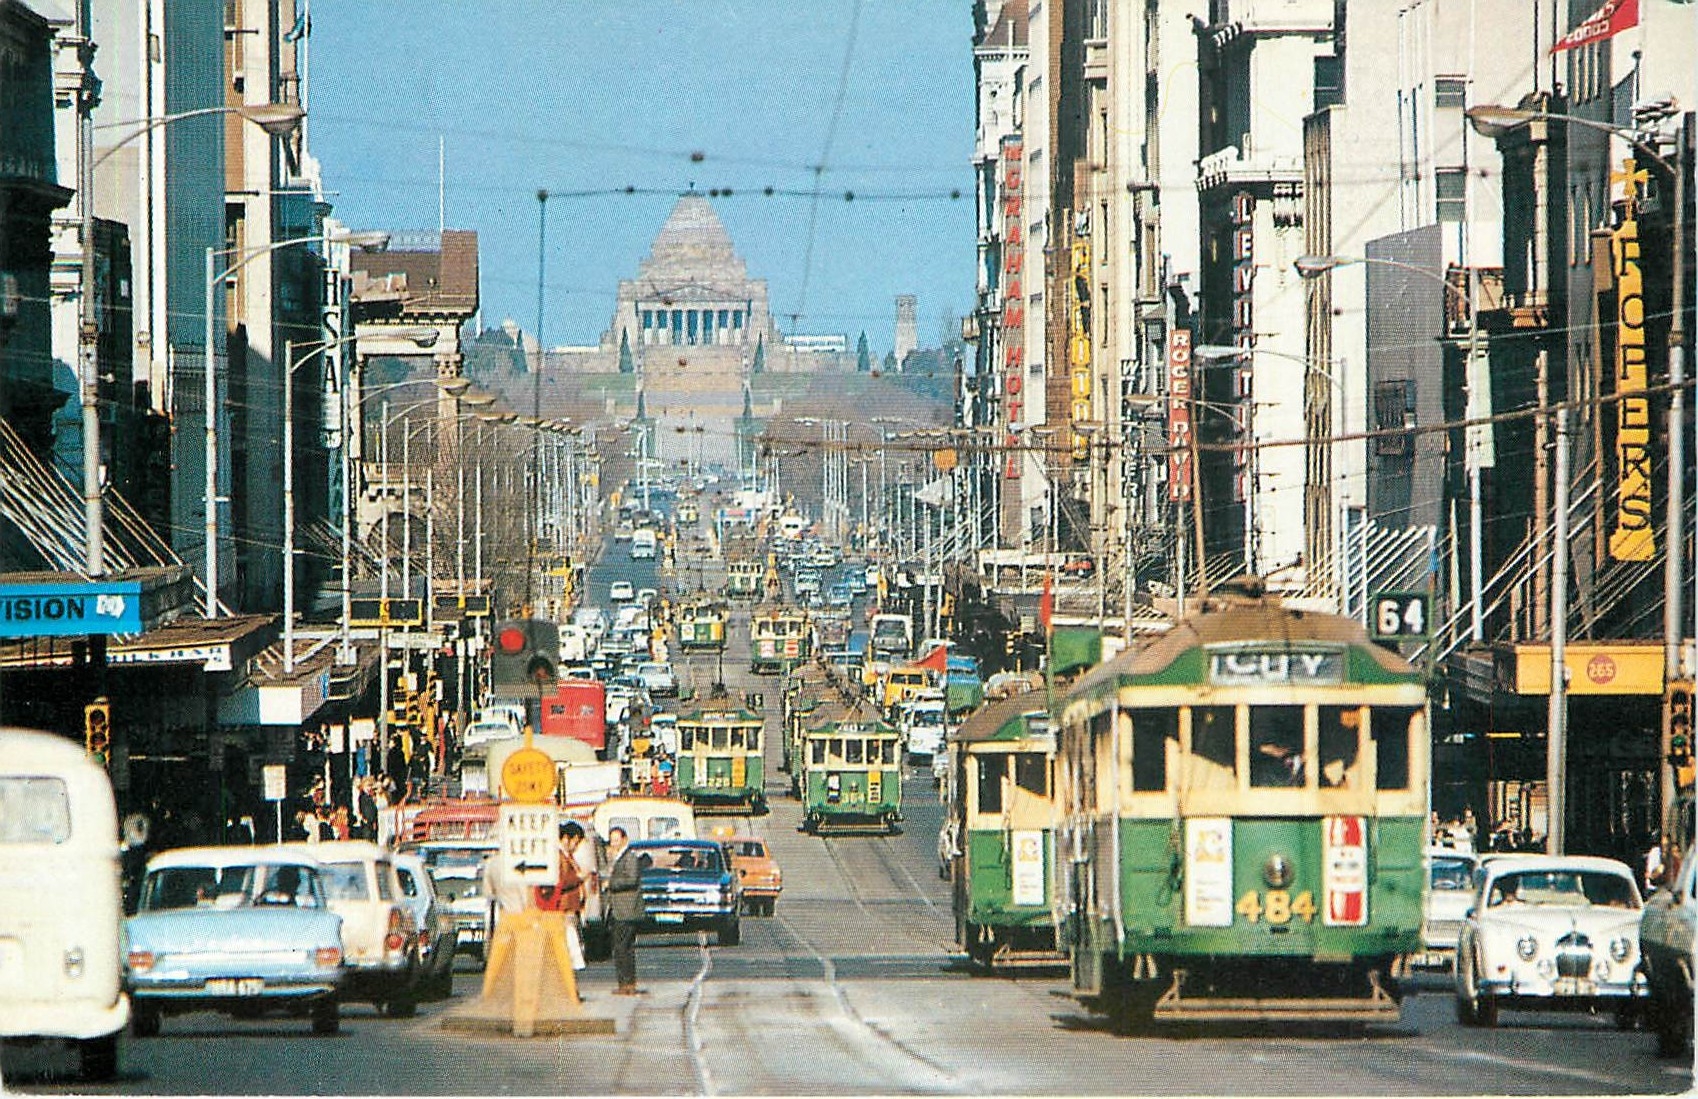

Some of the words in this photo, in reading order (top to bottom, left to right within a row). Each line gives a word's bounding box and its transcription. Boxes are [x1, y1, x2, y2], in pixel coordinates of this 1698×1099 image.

[1172, 334, 1189, 409] ROGER
[0, 597, 85, 620] ISION
[1378, 600, 1424, 634] 64
[1589, 662, 1613, 677] 265
[508, 813, 550, 830] KEEP
[510, 839, 548, 855] LEFT
[1235, 890, 1317, 923] 484
